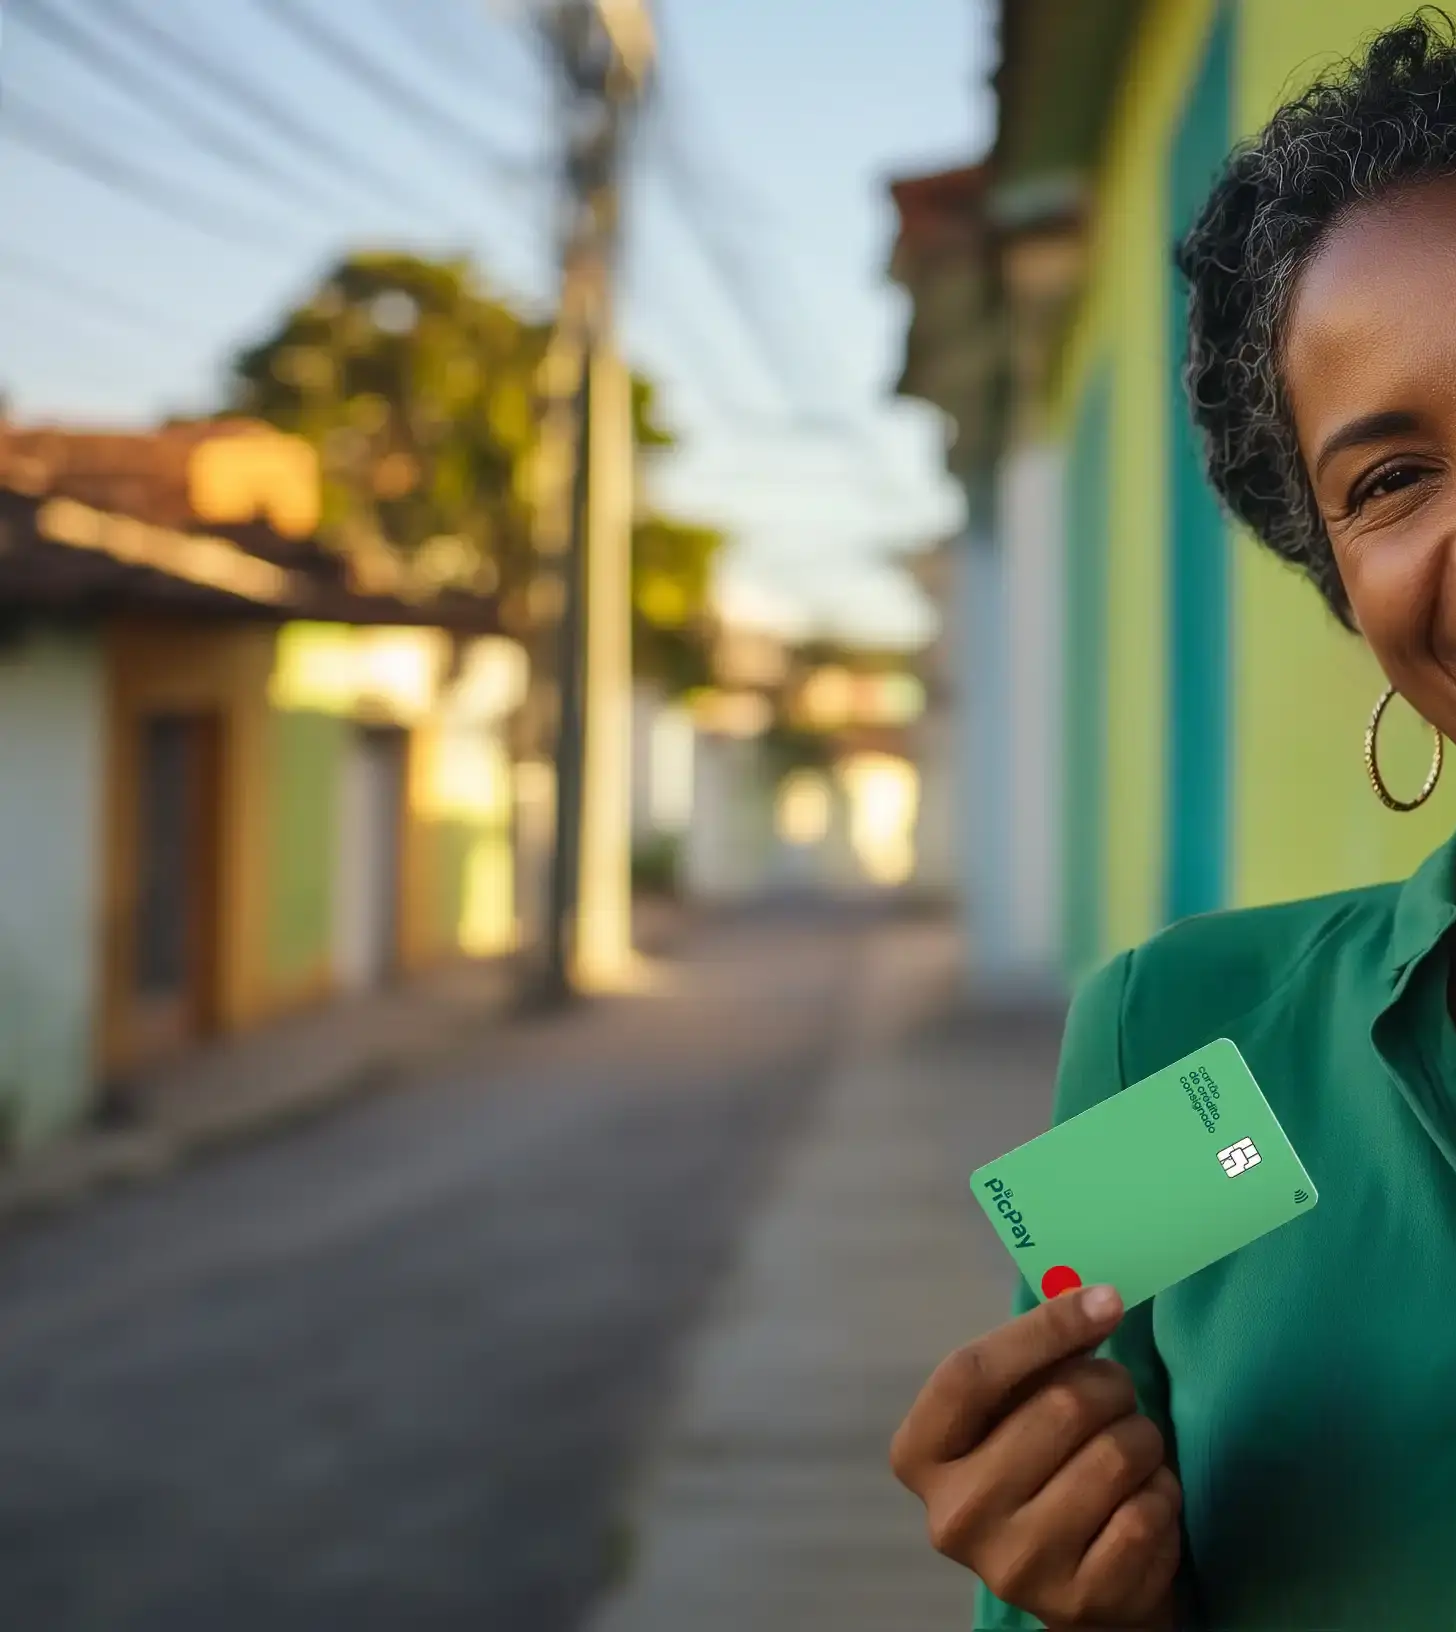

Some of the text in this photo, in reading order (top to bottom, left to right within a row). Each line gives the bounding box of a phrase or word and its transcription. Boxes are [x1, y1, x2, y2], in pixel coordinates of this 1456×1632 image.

[1180, 1076, 1215, 1134] consignado
[1189, 1071, 1220, 1120] de crédito
[1198, 1066, 1220, 1099] cartão
[984, 1178, 1036, 1248] PicPay
